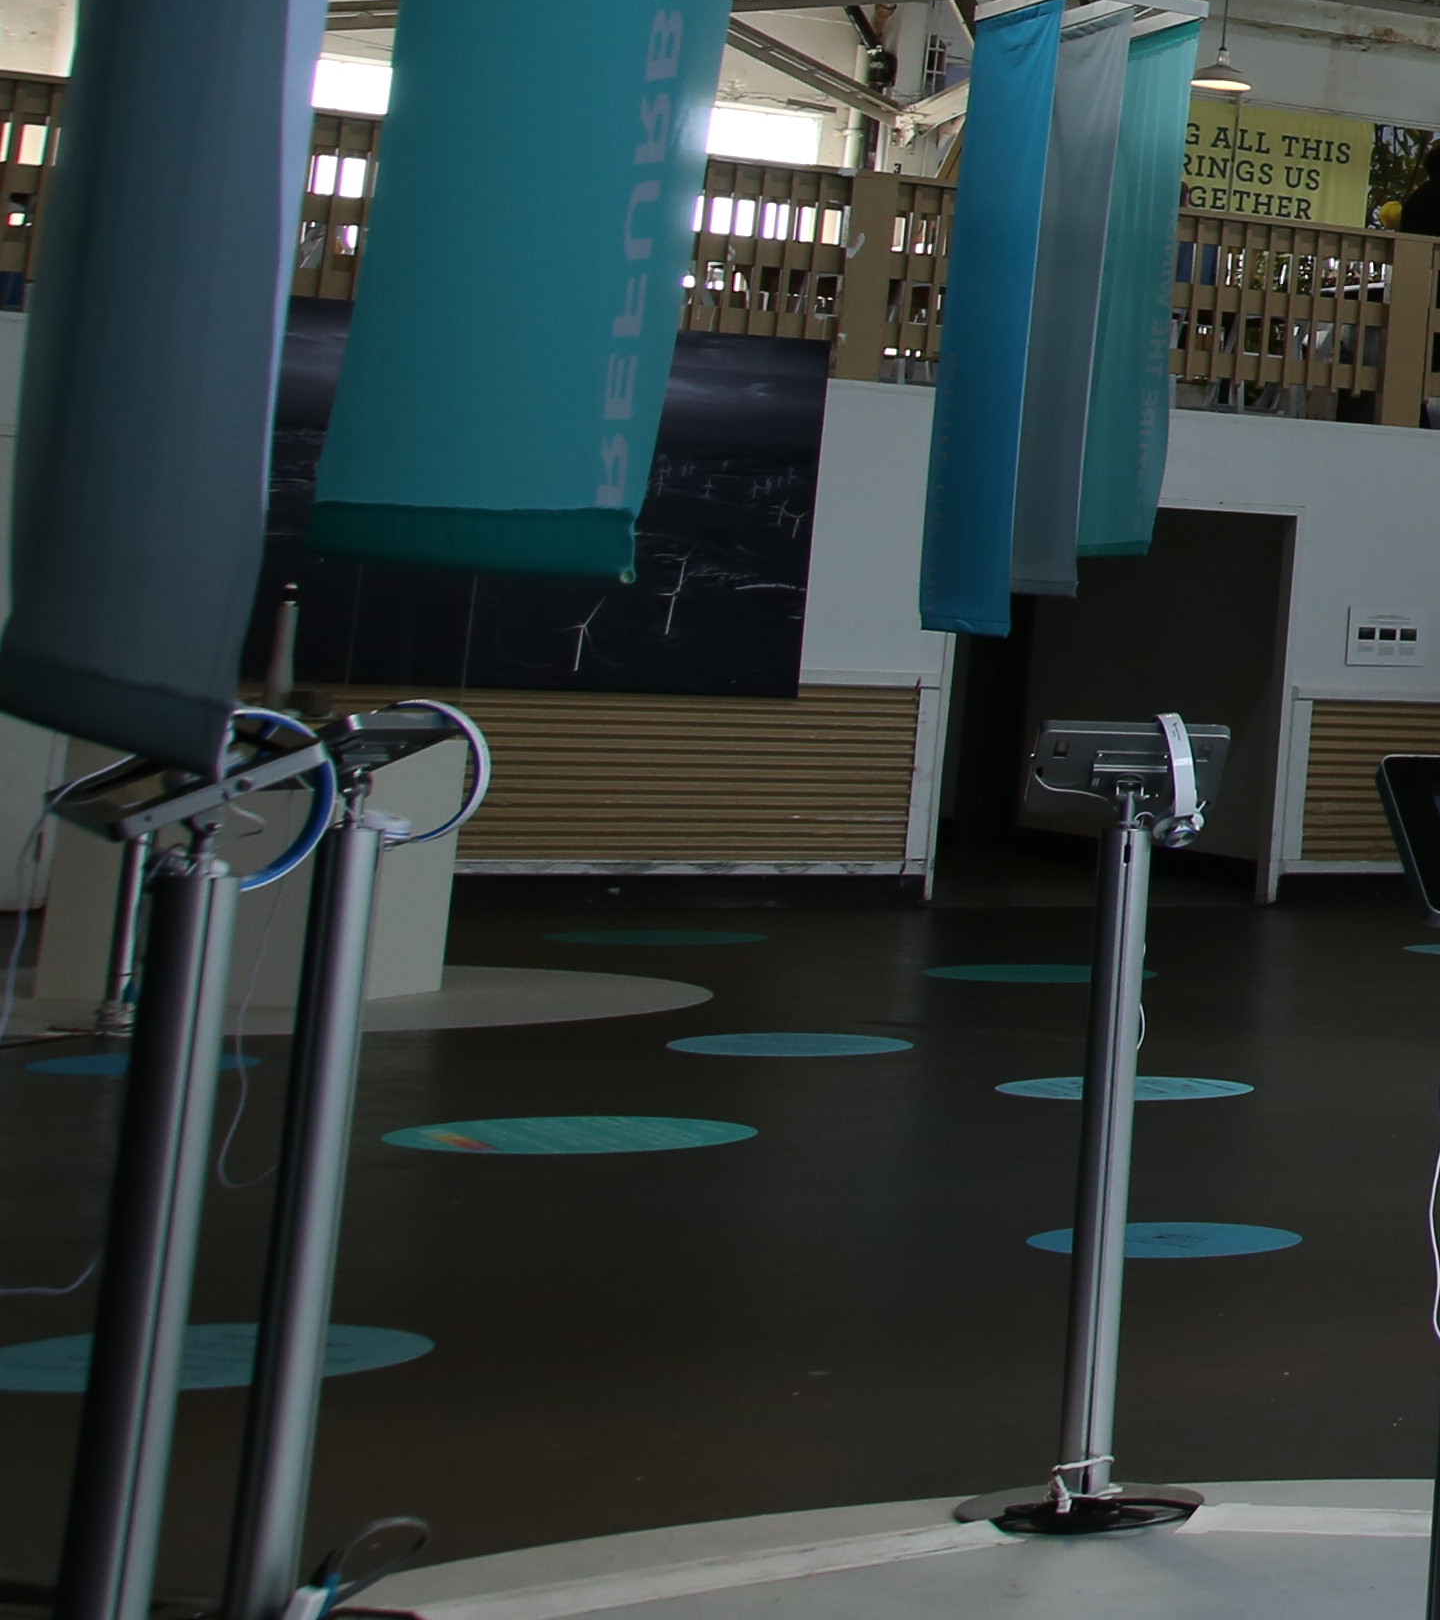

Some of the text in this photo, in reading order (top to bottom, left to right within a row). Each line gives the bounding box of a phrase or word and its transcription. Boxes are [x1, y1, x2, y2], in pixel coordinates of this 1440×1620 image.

[1211, 127, 1270, 154] ALL
[1282, 135, 1351, 164] THIS
[1286, 168, 1320, 190] US
